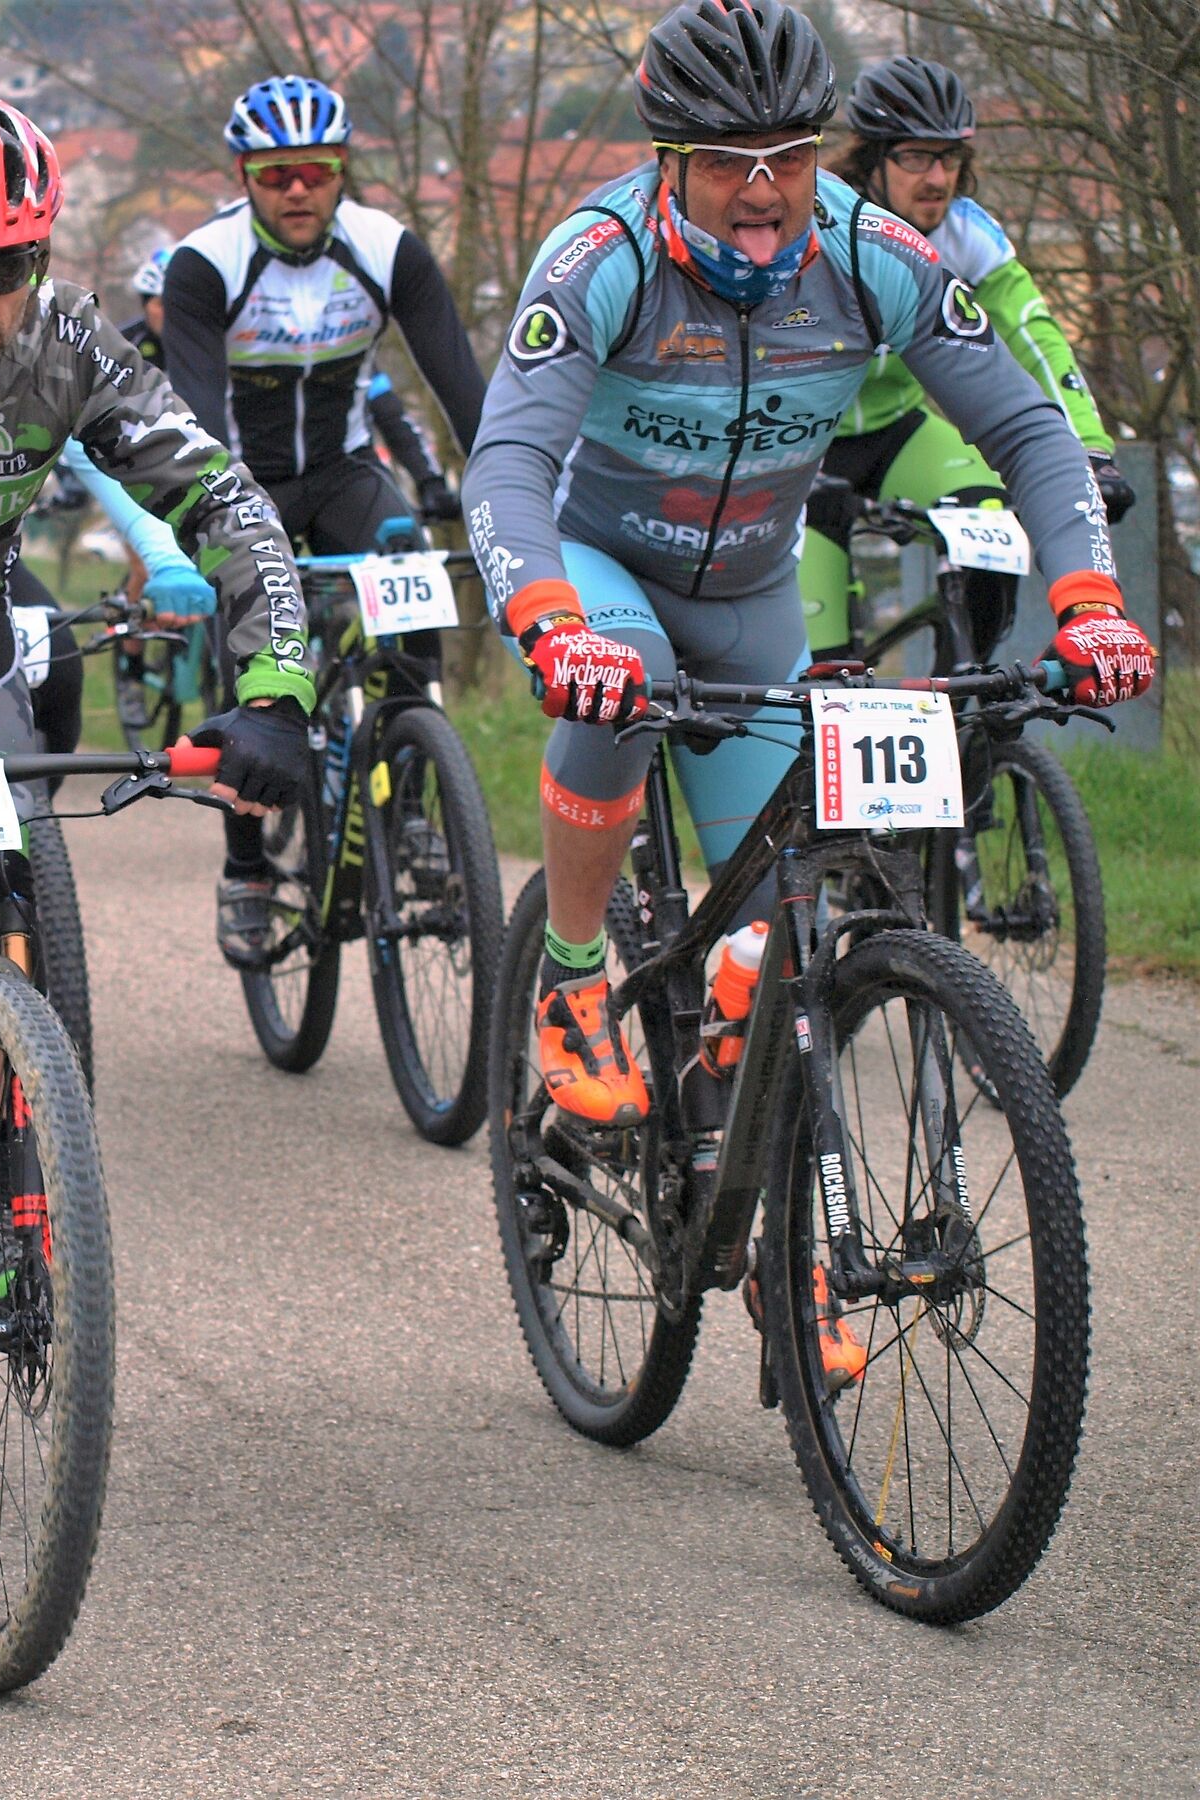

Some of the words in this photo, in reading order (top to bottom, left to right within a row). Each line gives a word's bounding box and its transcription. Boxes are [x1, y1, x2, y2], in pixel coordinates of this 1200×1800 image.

[627, 404, 702, 432] CICLI
[480, 500, 496, 538] CICLI
[470, 507, 507, 602] MATTEO
[250, 537, 311, 679] OSTERIA
[379, 575, 432, 605] 375
[825, 725, 840, 820] ABBONATO
[853, 735, 928, 784] 113
